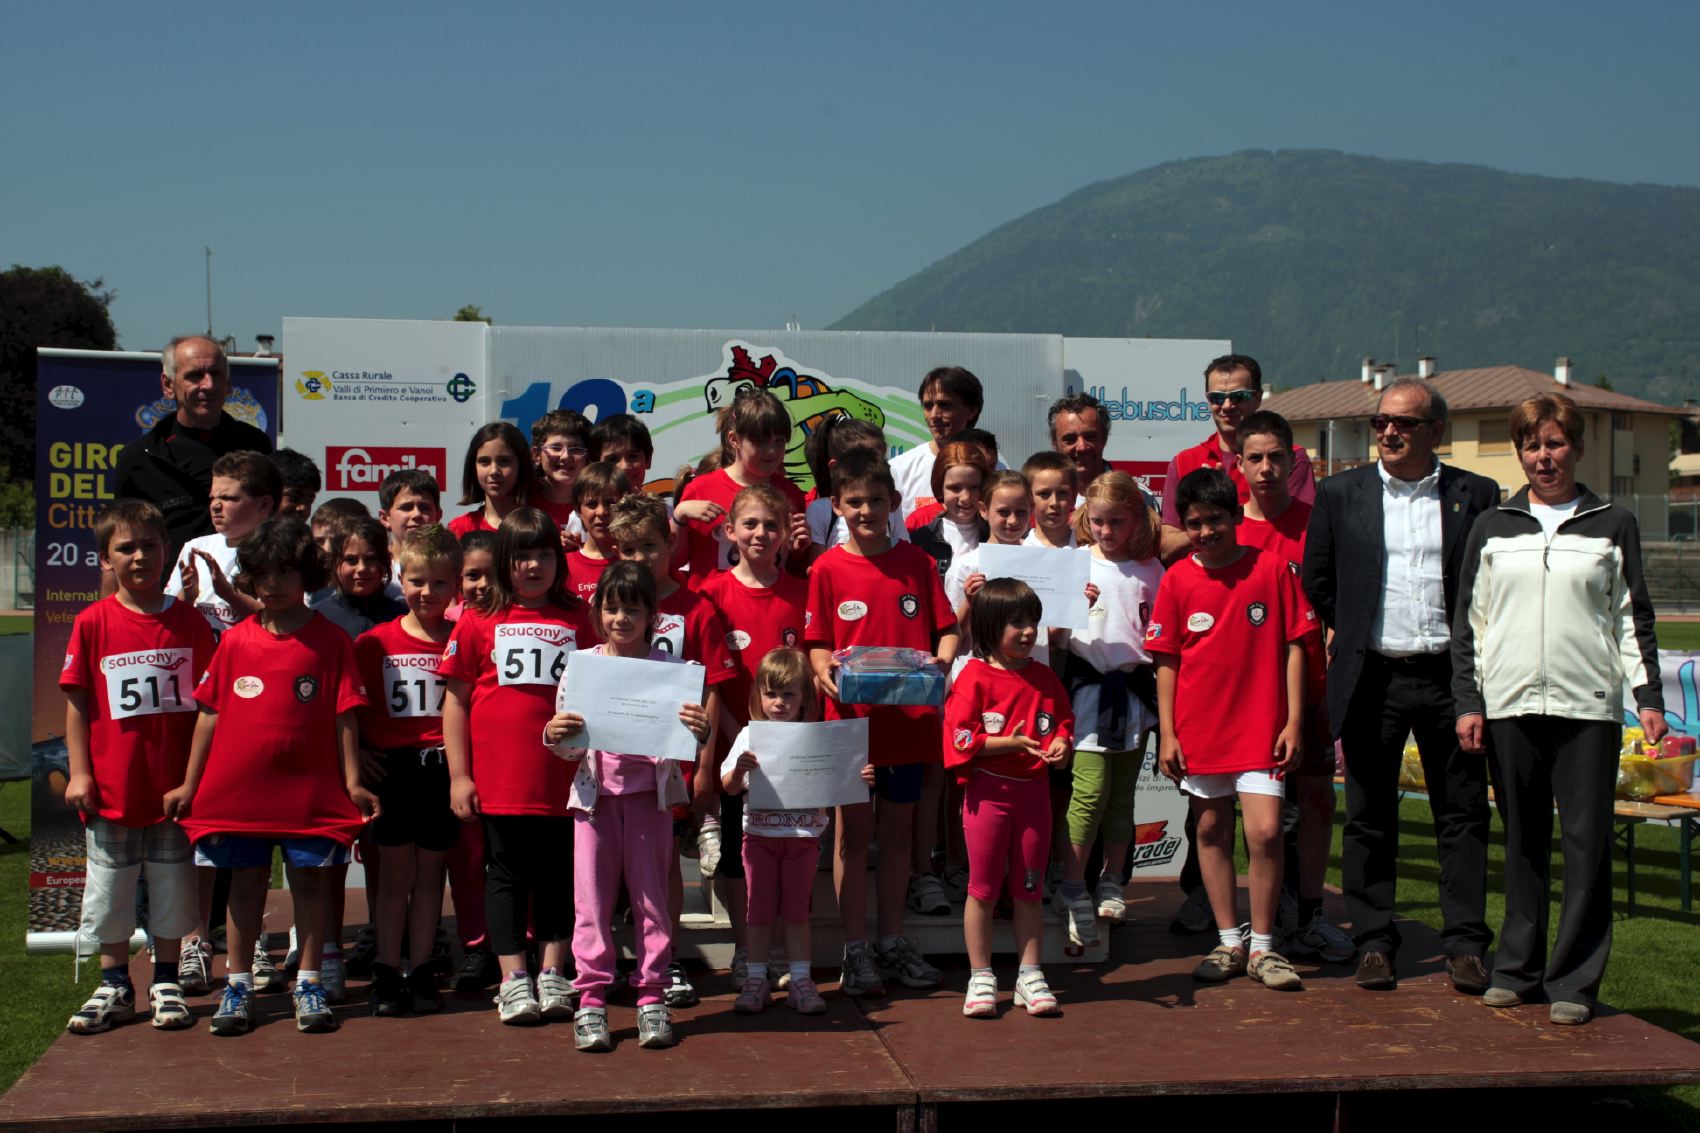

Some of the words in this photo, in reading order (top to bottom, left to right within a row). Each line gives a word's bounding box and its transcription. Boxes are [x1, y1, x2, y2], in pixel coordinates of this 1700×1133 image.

[332, 371, 360, 380] Cassa
[363, 371, 393, 380] Rurale
[333, 385, 352, 394] Valli
[354, 385, 362, 394] di
[364, 386, 400, 395] Primiero
[410, 386, 434, 395] Vanoi
[368, 394, 398, 402] Credito
[399, 394, 447, 403] Cooperativo
[47, 542, 78, 567] 20
[499, 626, 561, 638] saucony
[108, 653, 174, 669] saucony
[504, 648, 566, 682] 516
[120, 675, 182, 712] 511
